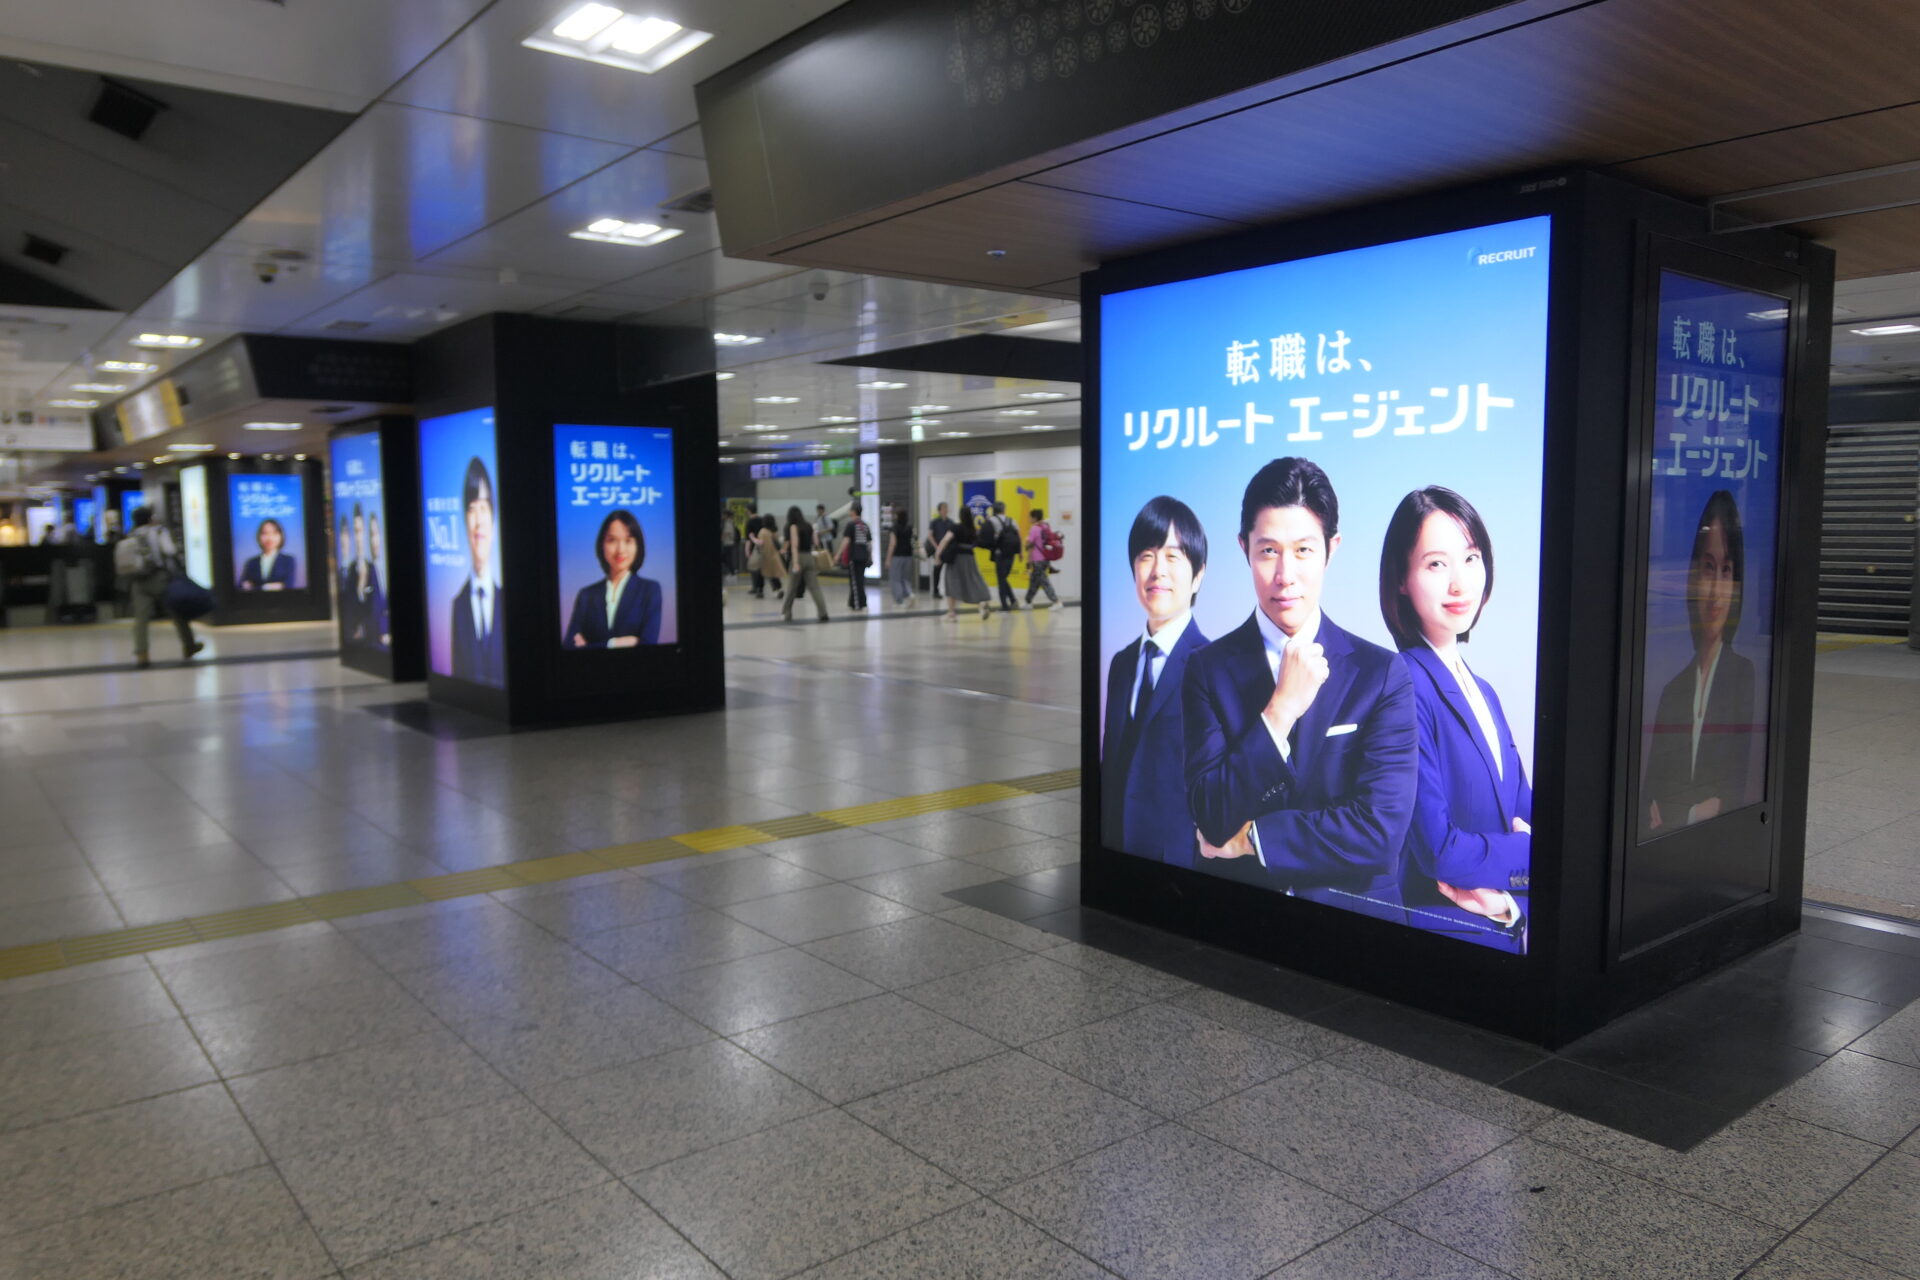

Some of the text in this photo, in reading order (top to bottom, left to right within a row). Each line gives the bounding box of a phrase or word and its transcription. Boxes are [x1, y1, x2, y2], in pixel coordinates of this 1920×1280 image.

[1478, 246, 1536, 265] RECRUIT
[1225, 330, 1373, 386] 転職は、
[1672, 315, 1745, 368] 転職は、
[1124, 383, 1515, 451] リクルート エージェント
[1671, 373, 1759, 425] リクルート
[570, 462, 651, 483] リクルート
[865, 463, 875, 488] 5
[1667, 432, 1768, 479] エージェント
[571, 485, 662, 506] エージェント
